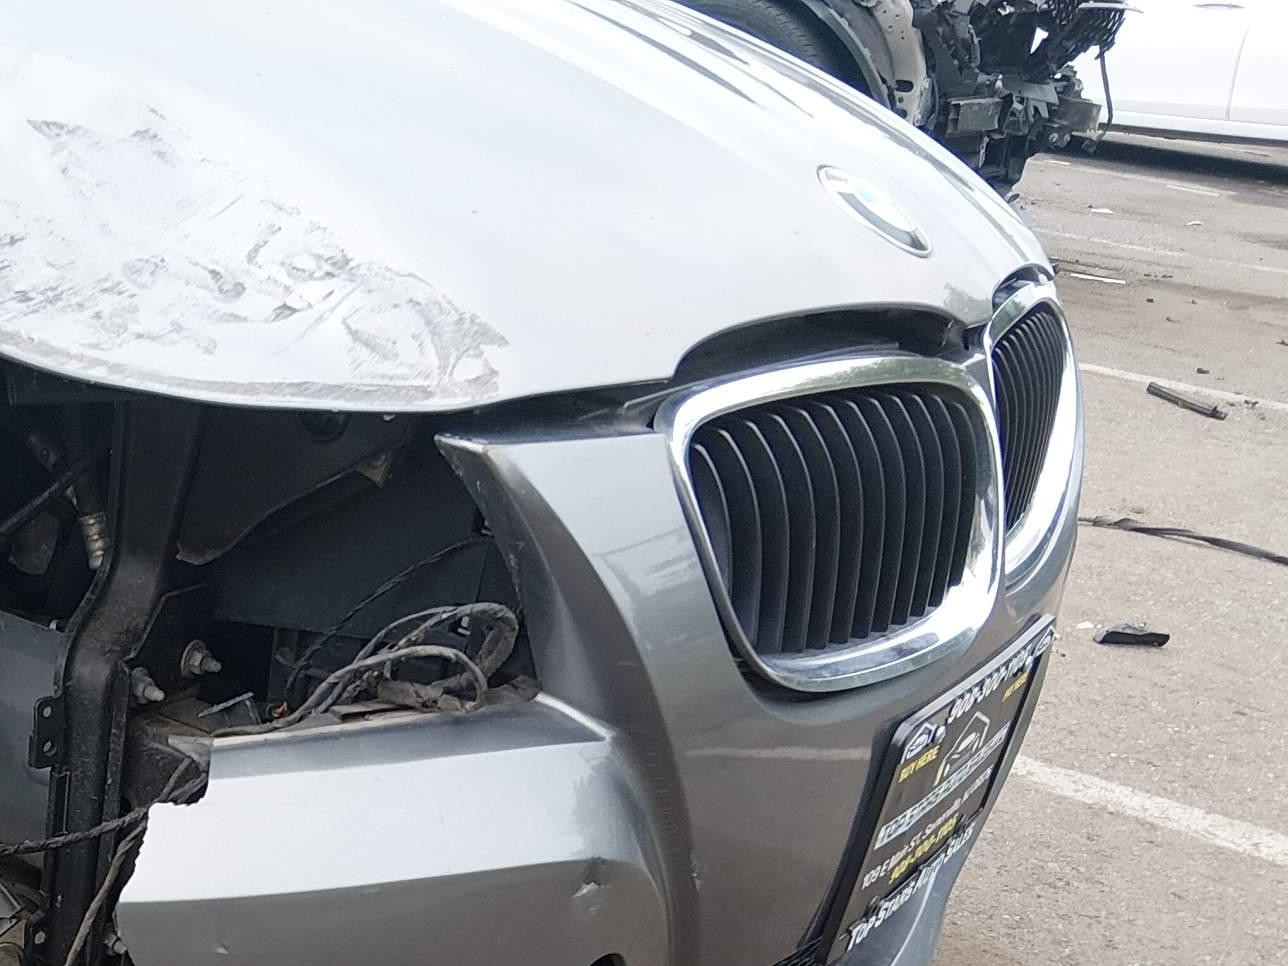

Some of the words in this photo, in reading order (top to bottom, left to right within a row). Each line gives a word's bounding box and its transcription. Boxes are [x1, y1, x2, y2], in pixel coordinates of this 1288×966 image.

[898, 760, 917, 783] BUY
[915, 744, 941, 771] HERE
[879, 859, 891, 878] E
[847, 915, 877, 953] TOP
[874, 880, 916, 928] STARS
[912, 851, 946, 894] AUTO
